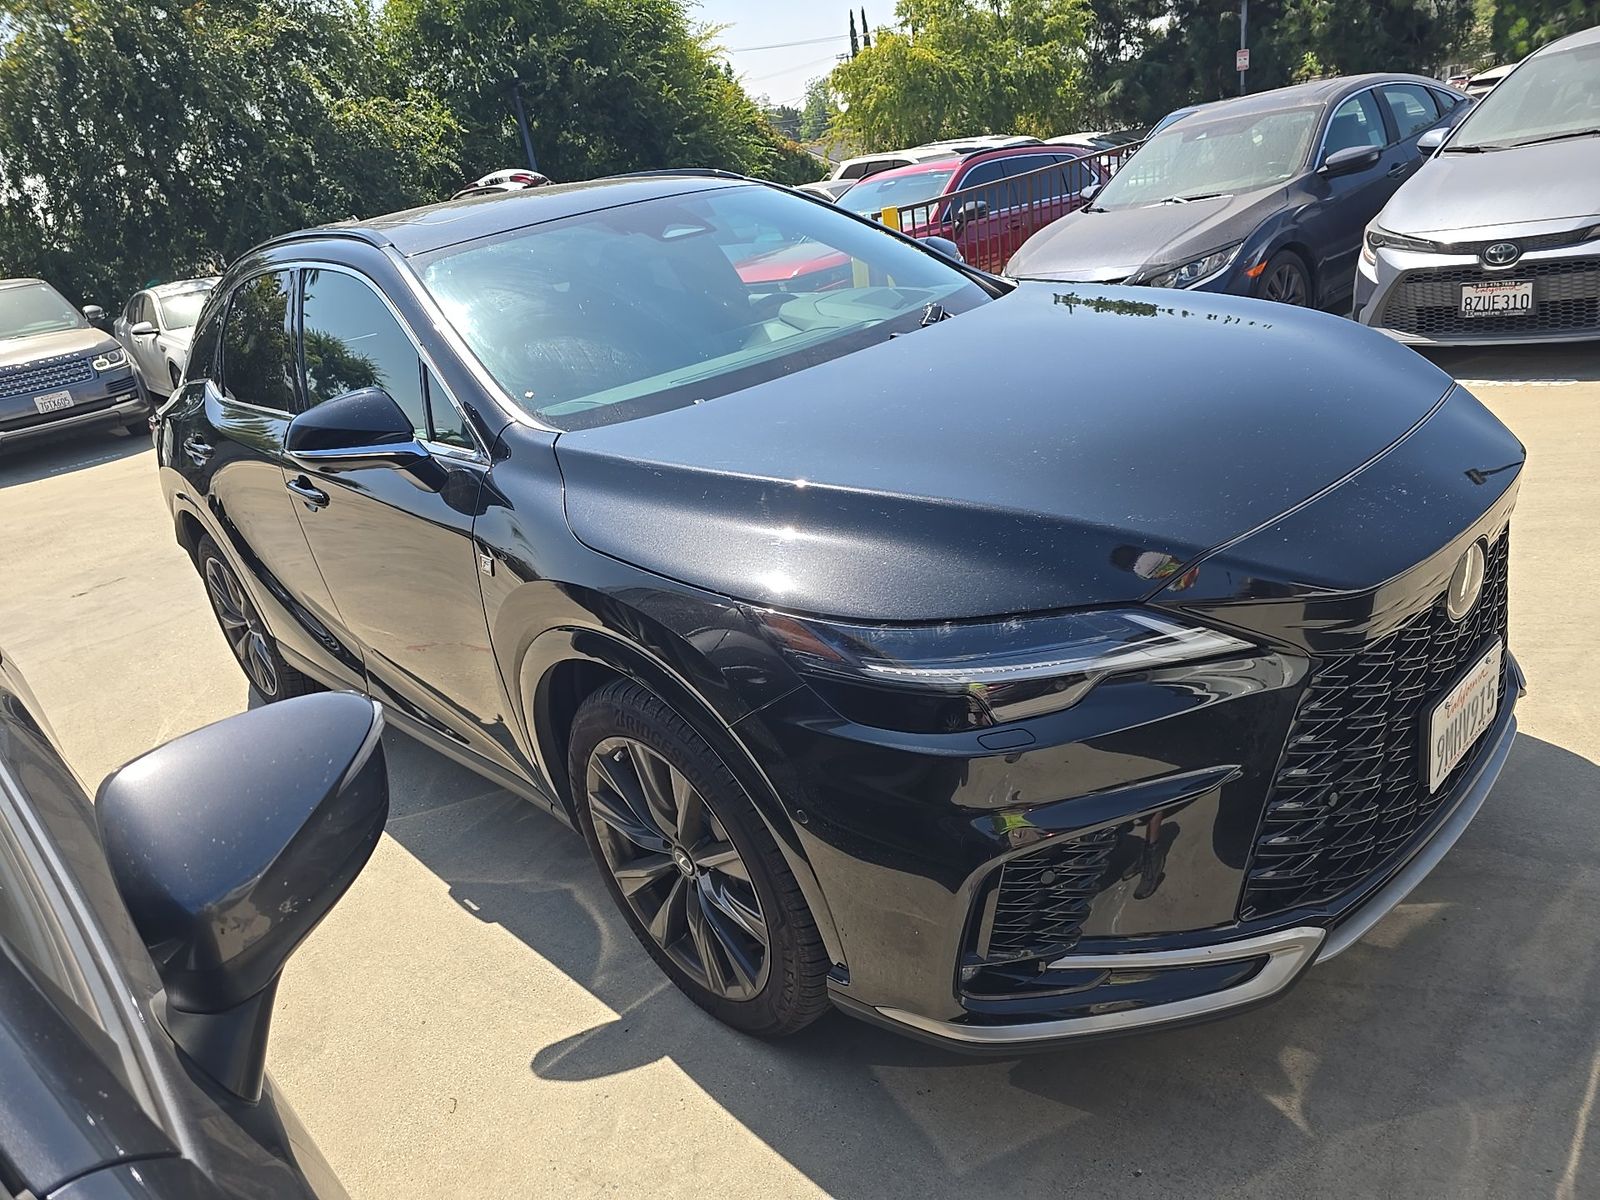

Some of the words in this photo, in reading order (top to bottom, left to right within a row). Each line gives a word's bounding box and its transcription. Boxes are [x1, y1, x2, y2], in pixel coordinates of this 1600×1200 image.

[1464, 294, 1530, 311] 8ZUE310
[1465, 309, 1500, 318] Empire
[1446, 669, 1488, 719] California
[1436, 675, 1496, 778] 9MHV915
